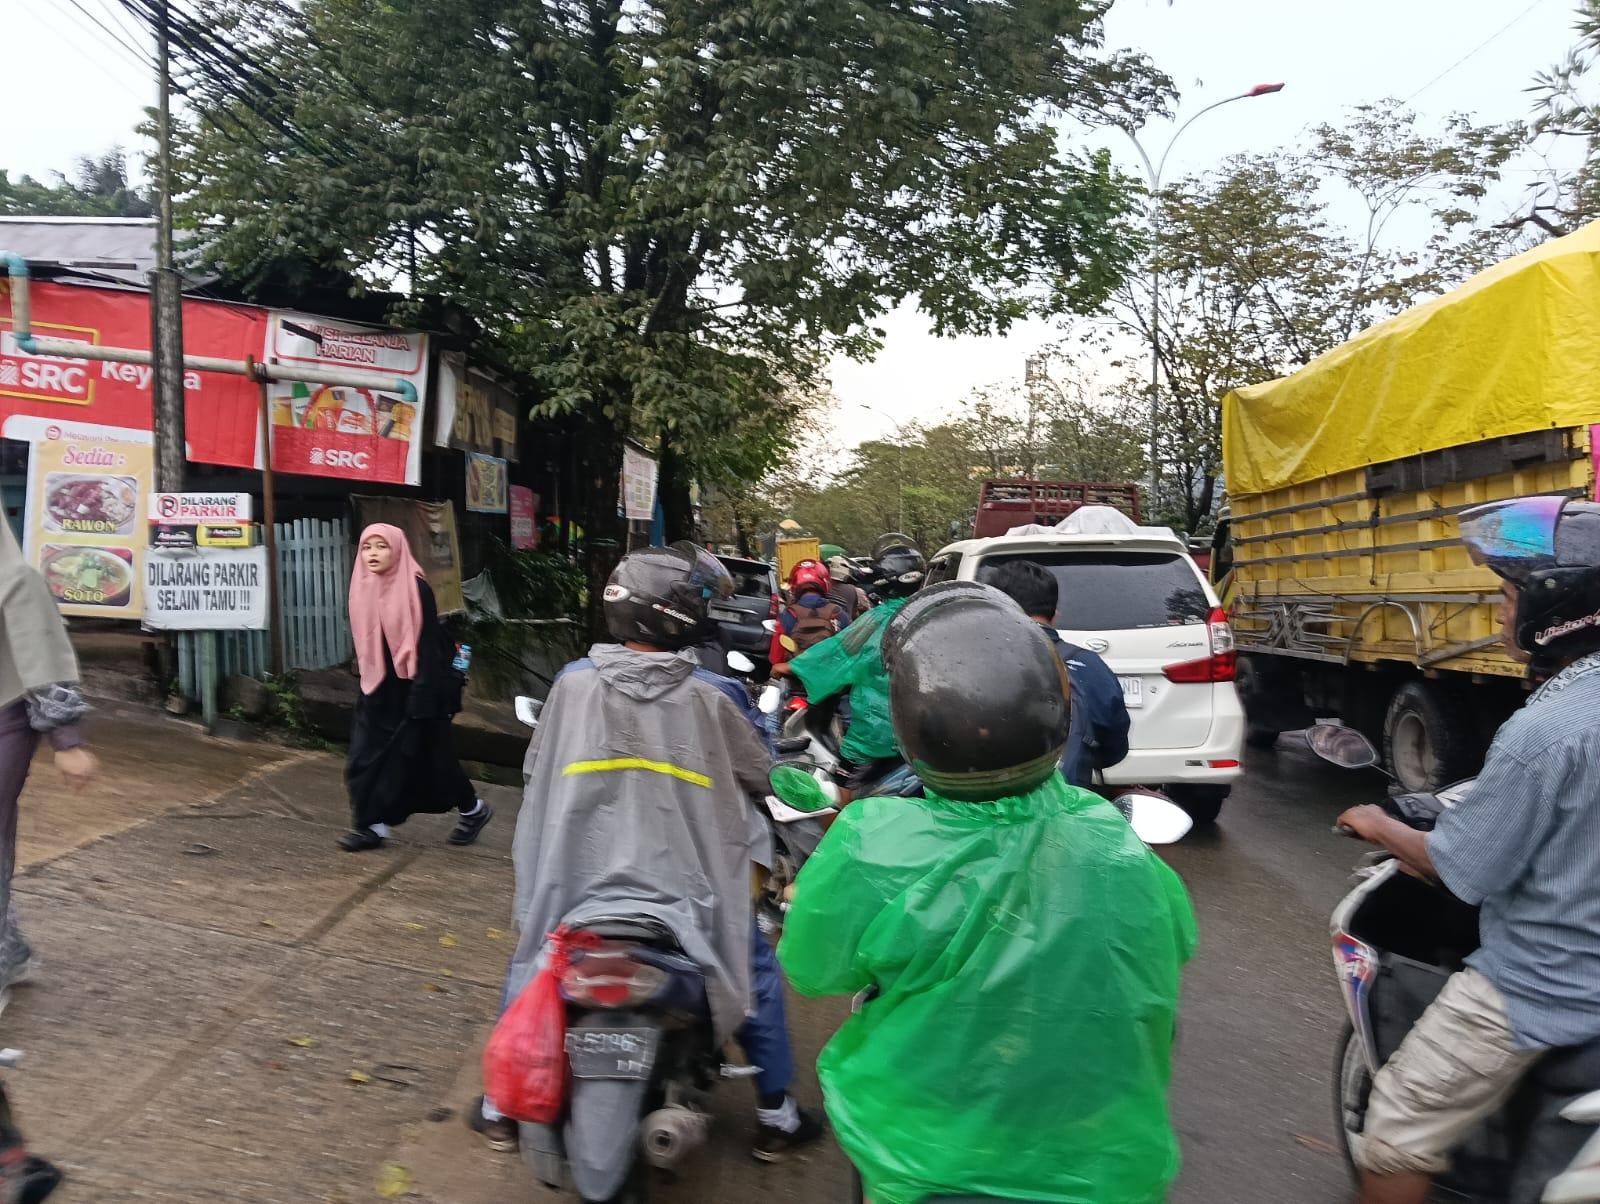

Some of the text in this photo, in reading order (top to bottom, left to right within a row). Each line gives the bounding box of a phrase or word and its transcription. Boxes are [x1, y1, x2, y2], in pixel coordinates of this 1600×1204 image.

[316, 343, 376, 363] HARIAN
[20, 361, 85, 394] SRC
[325, 448, 370, 470] SRC
[180, 506, 237, 516] PARKIR
[62, 518, 116, 534] RAWON
[148, 562, 259, 586] DILARANG PARKIR
[63, 588, 105, 602] SOTO
[157, 589, 200, 611] SELAIN
[203, 589, 236, 611] TAMU
